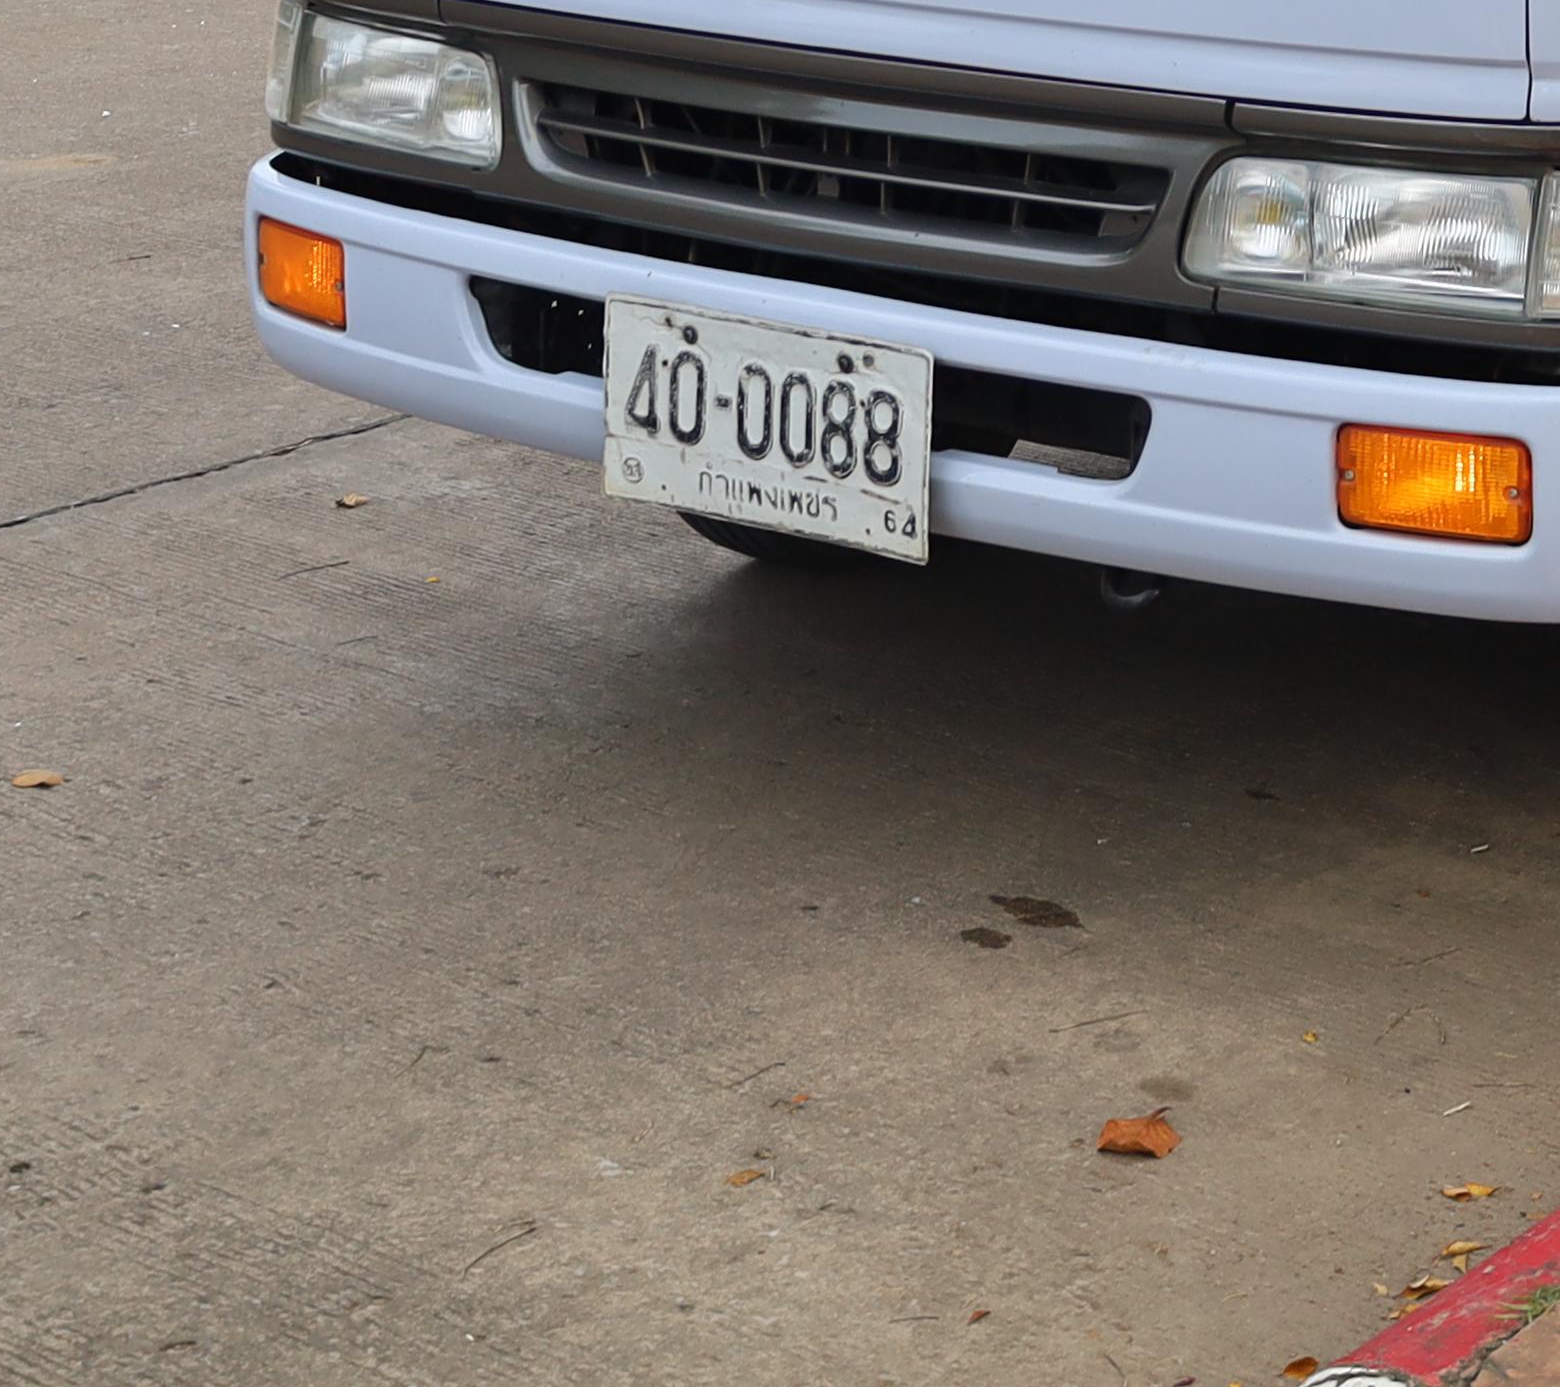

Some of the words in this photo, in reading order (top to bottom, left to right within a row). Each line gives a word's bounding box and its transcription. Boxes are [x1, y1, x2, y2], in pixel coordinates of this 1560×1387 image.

[625, 343, 903, 486] 40-0088
[698, 462, 839, 522] กำแพงเพชร
